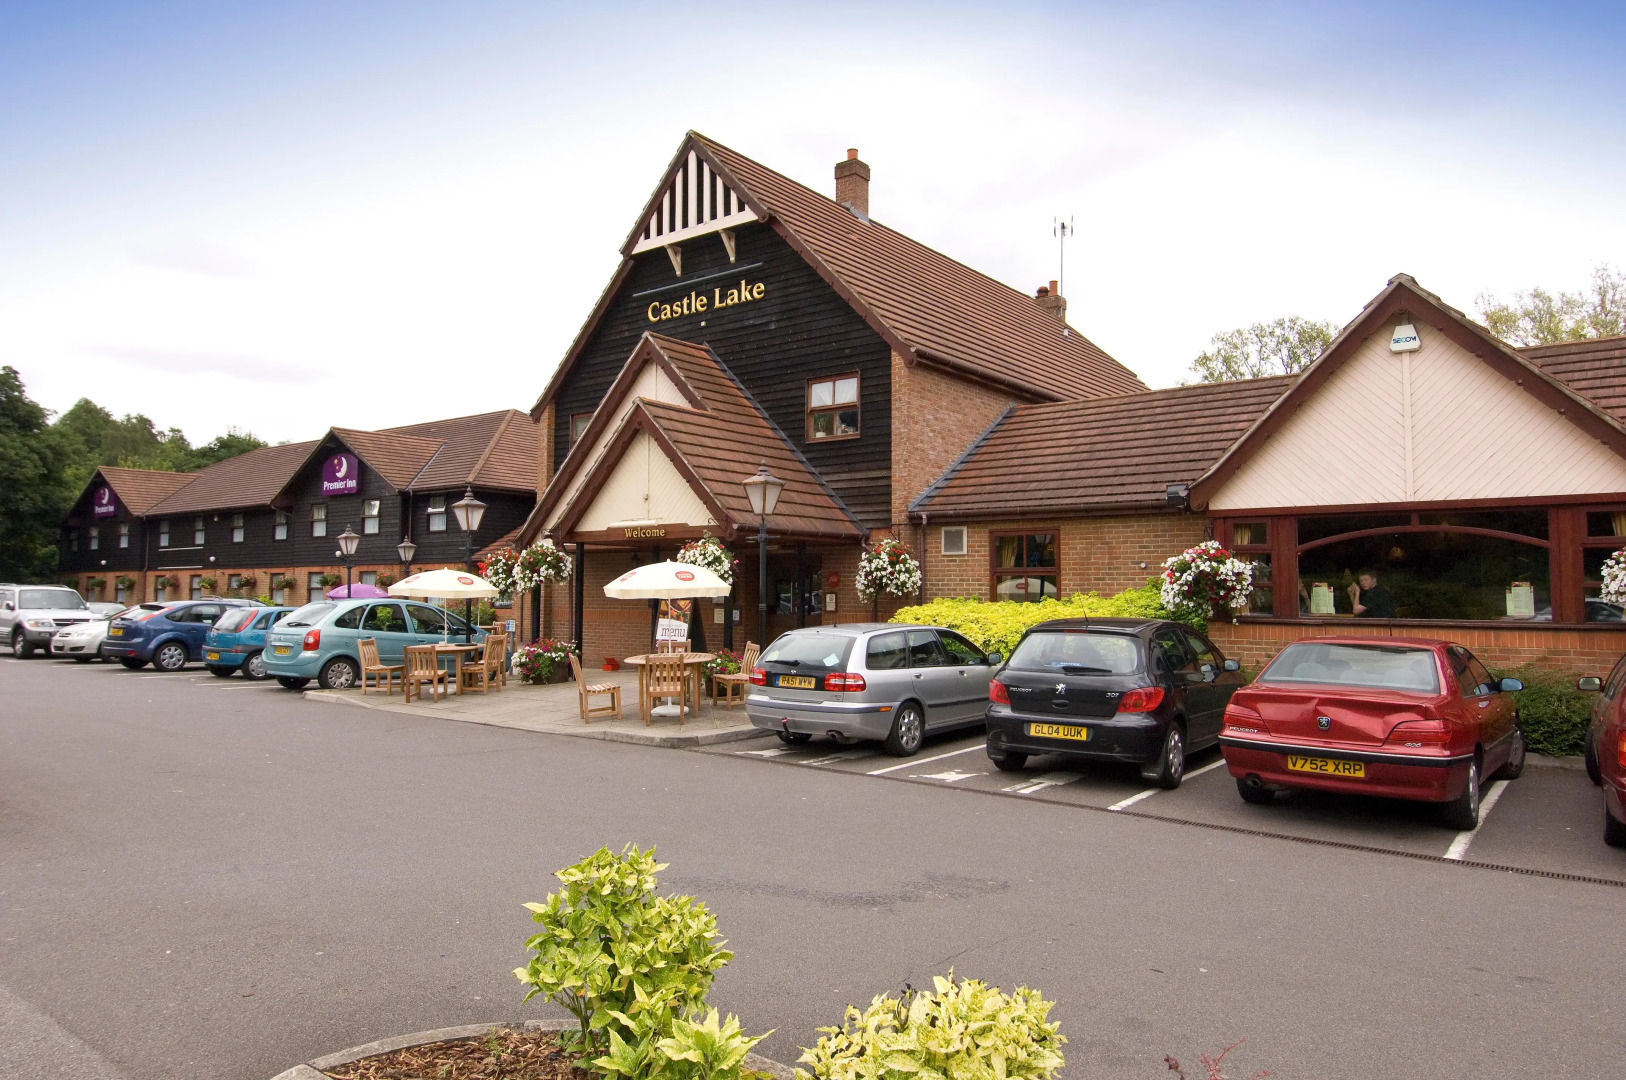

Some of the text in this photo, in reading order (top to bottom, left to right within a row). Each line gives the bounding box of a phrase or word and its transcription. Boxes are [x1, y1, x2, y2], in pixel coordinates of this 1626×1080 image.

[647, 279, 765, 322] Castle Lake
[1393, 336, 1416, 344] SECOM
[323, 478, 357, 491] Premier Inn
[624, 526, 666, 538] Welcome
[660, 627, 686, 638] menu
[1034, 724, 1083, 738] GL04 UUK
[1229, 726, 1258, 734] PEUGEOT
[1289, 756, 1363, 776] V752 XRP
